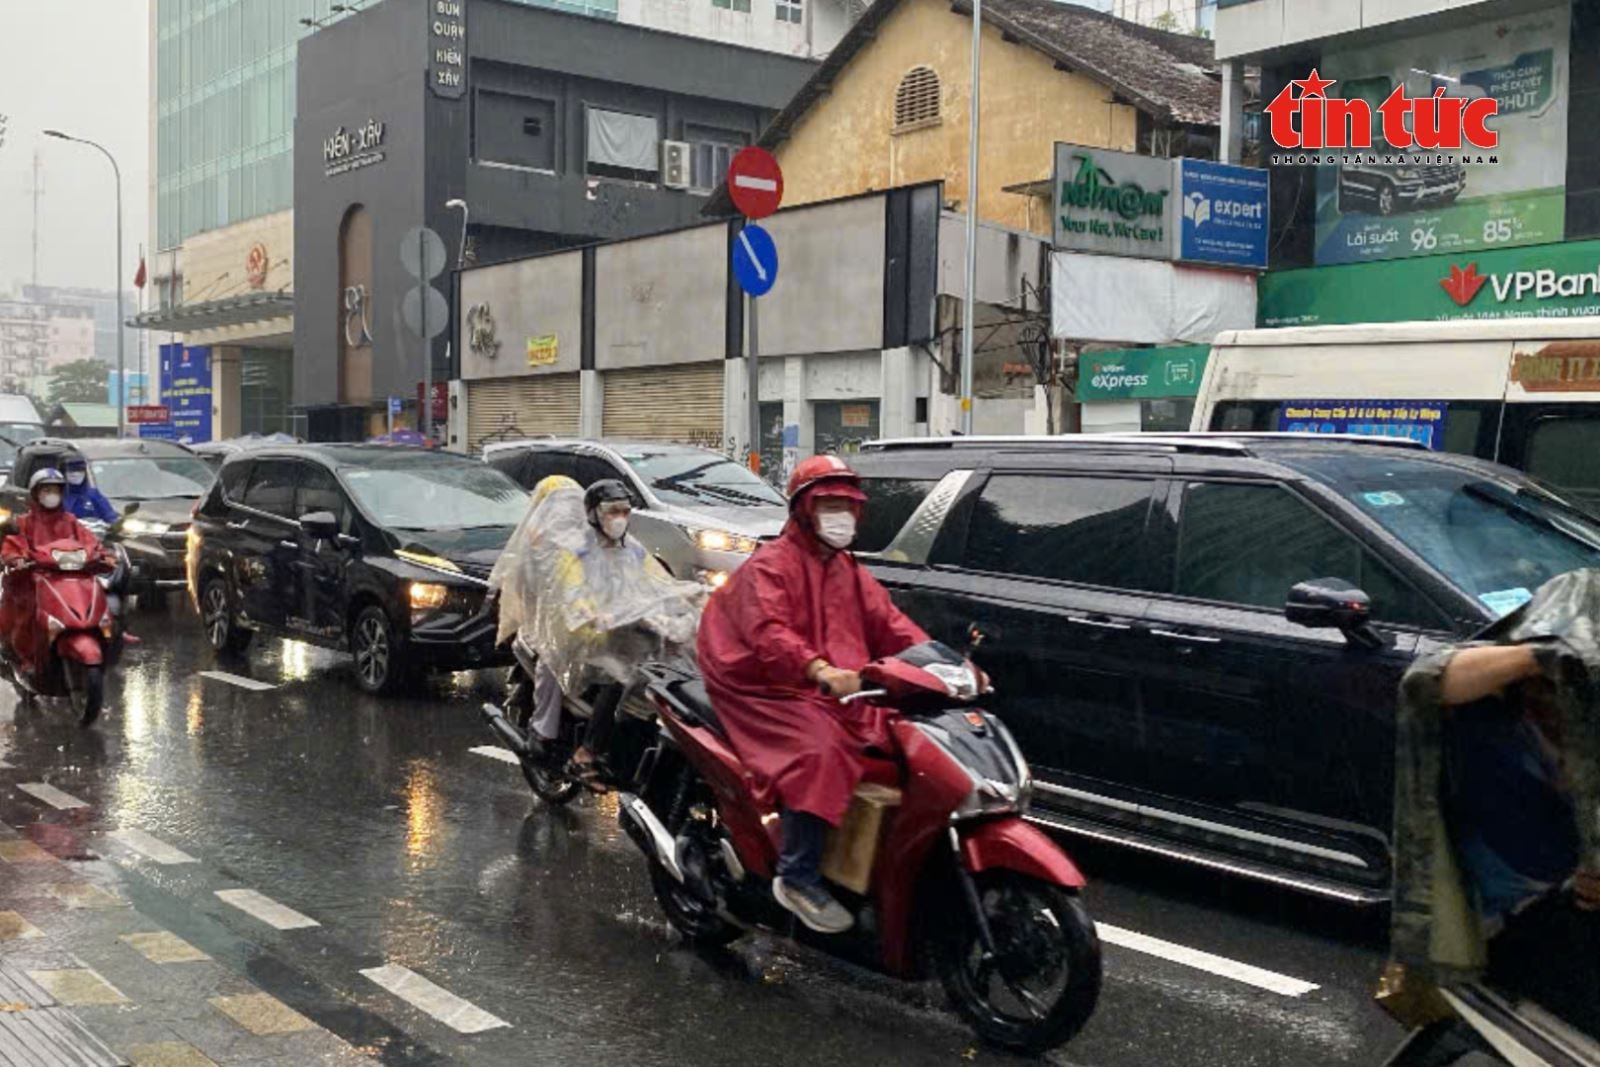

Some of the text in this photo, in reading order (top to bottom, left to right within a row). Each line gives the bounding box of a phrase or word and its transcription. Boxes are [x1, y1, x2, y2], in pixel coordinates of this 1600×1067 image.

[1214, 199, 1262, 219] expert
[1346, 231, 1368, 247] Lãi
[1369, 225, 1399, 246] suất
[1410, 228, 1438, 251] 96
[1489, 265, 1600, 302] VPBan
[1091, 374, 1148, 391] express
